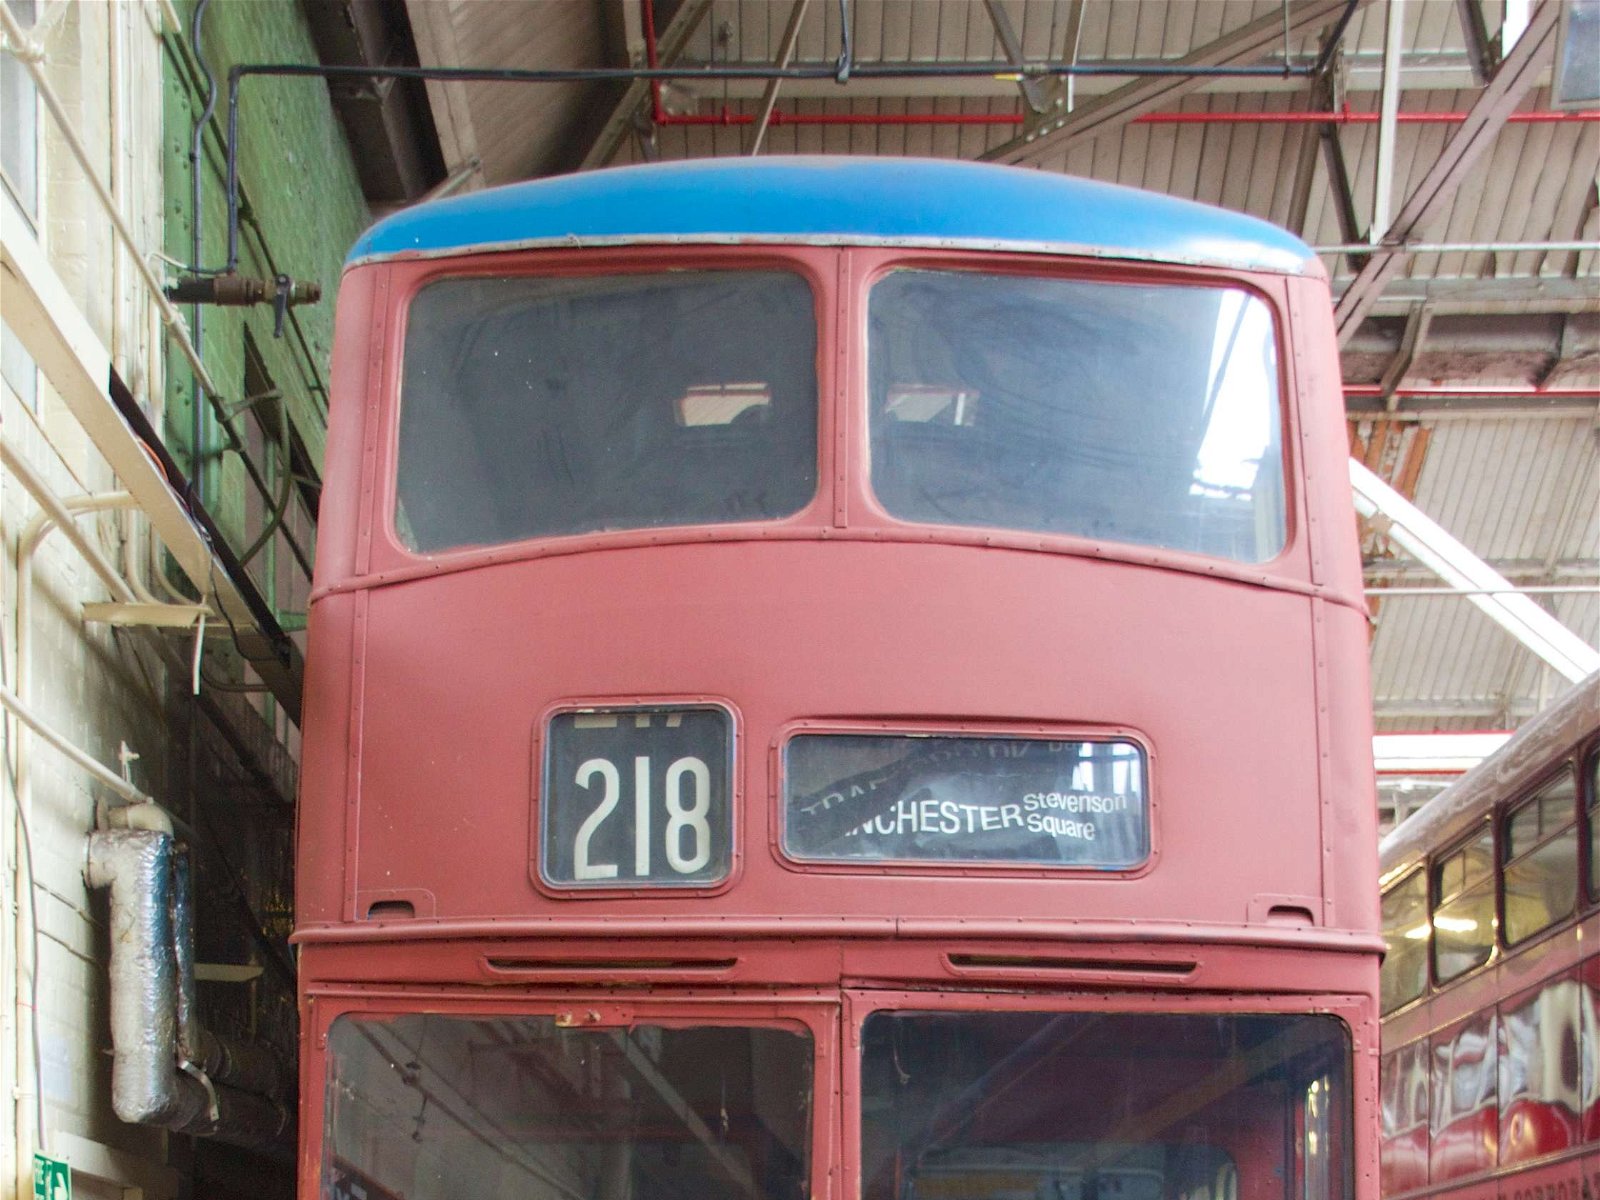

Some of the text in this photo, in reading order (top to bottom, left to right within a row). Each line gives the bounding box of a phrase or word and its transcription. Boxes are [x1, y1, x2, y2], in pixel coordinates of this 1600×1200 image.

[1023, 792, 1128, 815] Stevenson
[574, 756, 711, 880] 218
[1027, 813, 1095, 841] Square
